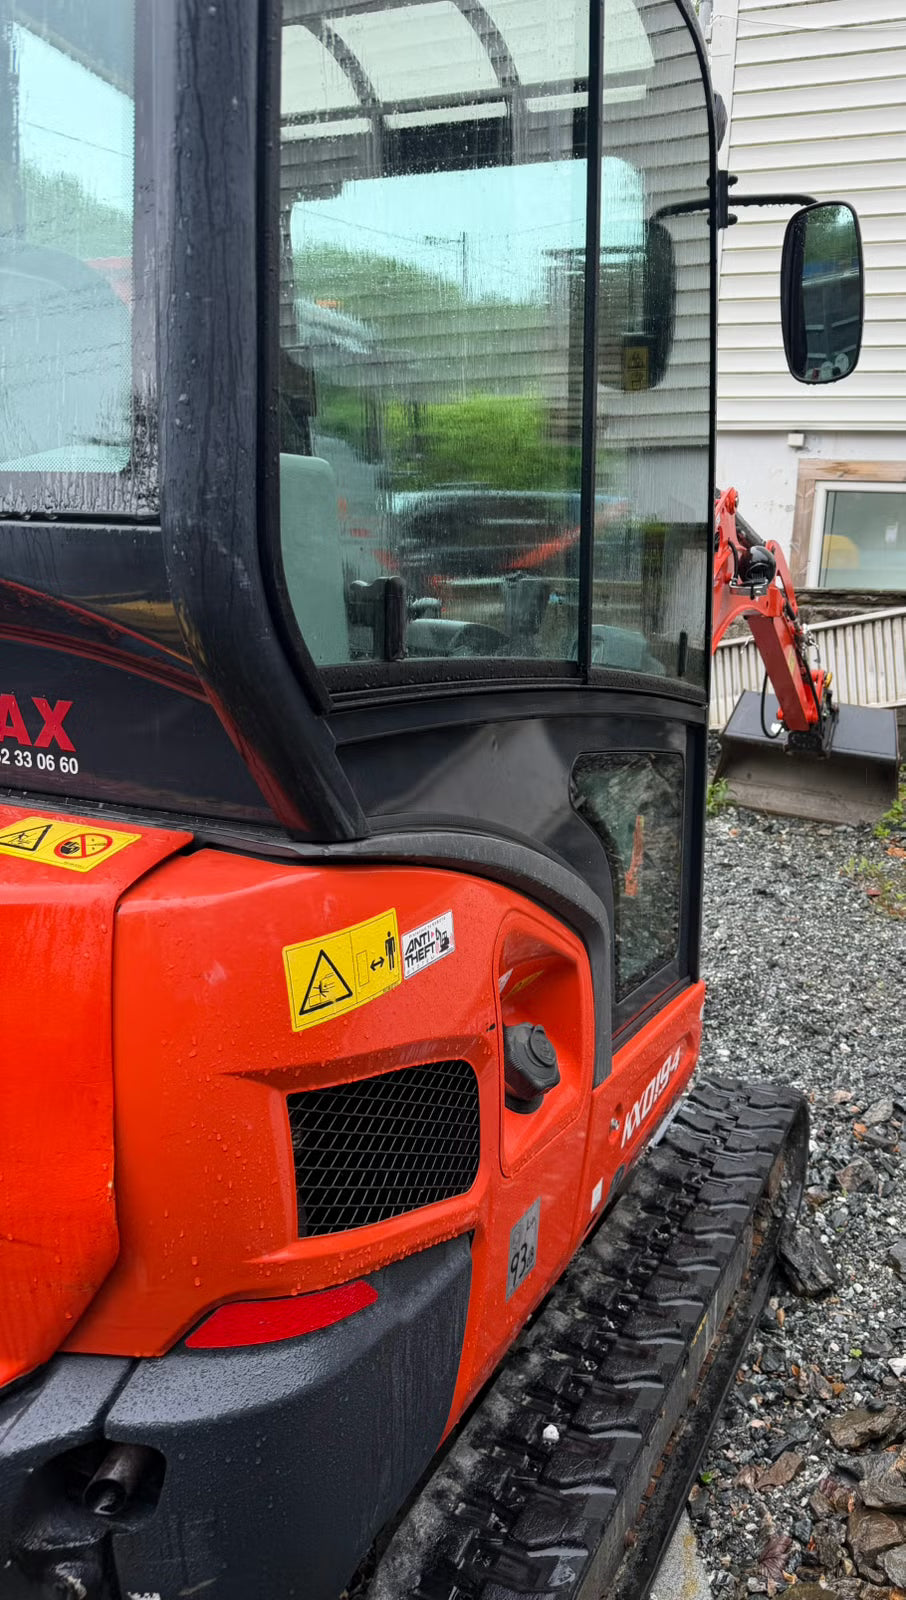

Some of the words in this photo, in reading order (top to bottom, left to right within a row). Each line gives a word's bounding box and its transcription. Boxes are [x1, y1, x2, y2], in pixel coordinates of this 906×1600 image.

[0, 748, 11, 765] 2
[14, 749, 33, 768] 33
[36, 753, 55, 771] 06
[59, 756, 79, 775] 60
[404, 940, 436, 968] THEFT
[405, 930, 430, 956] ANTI
